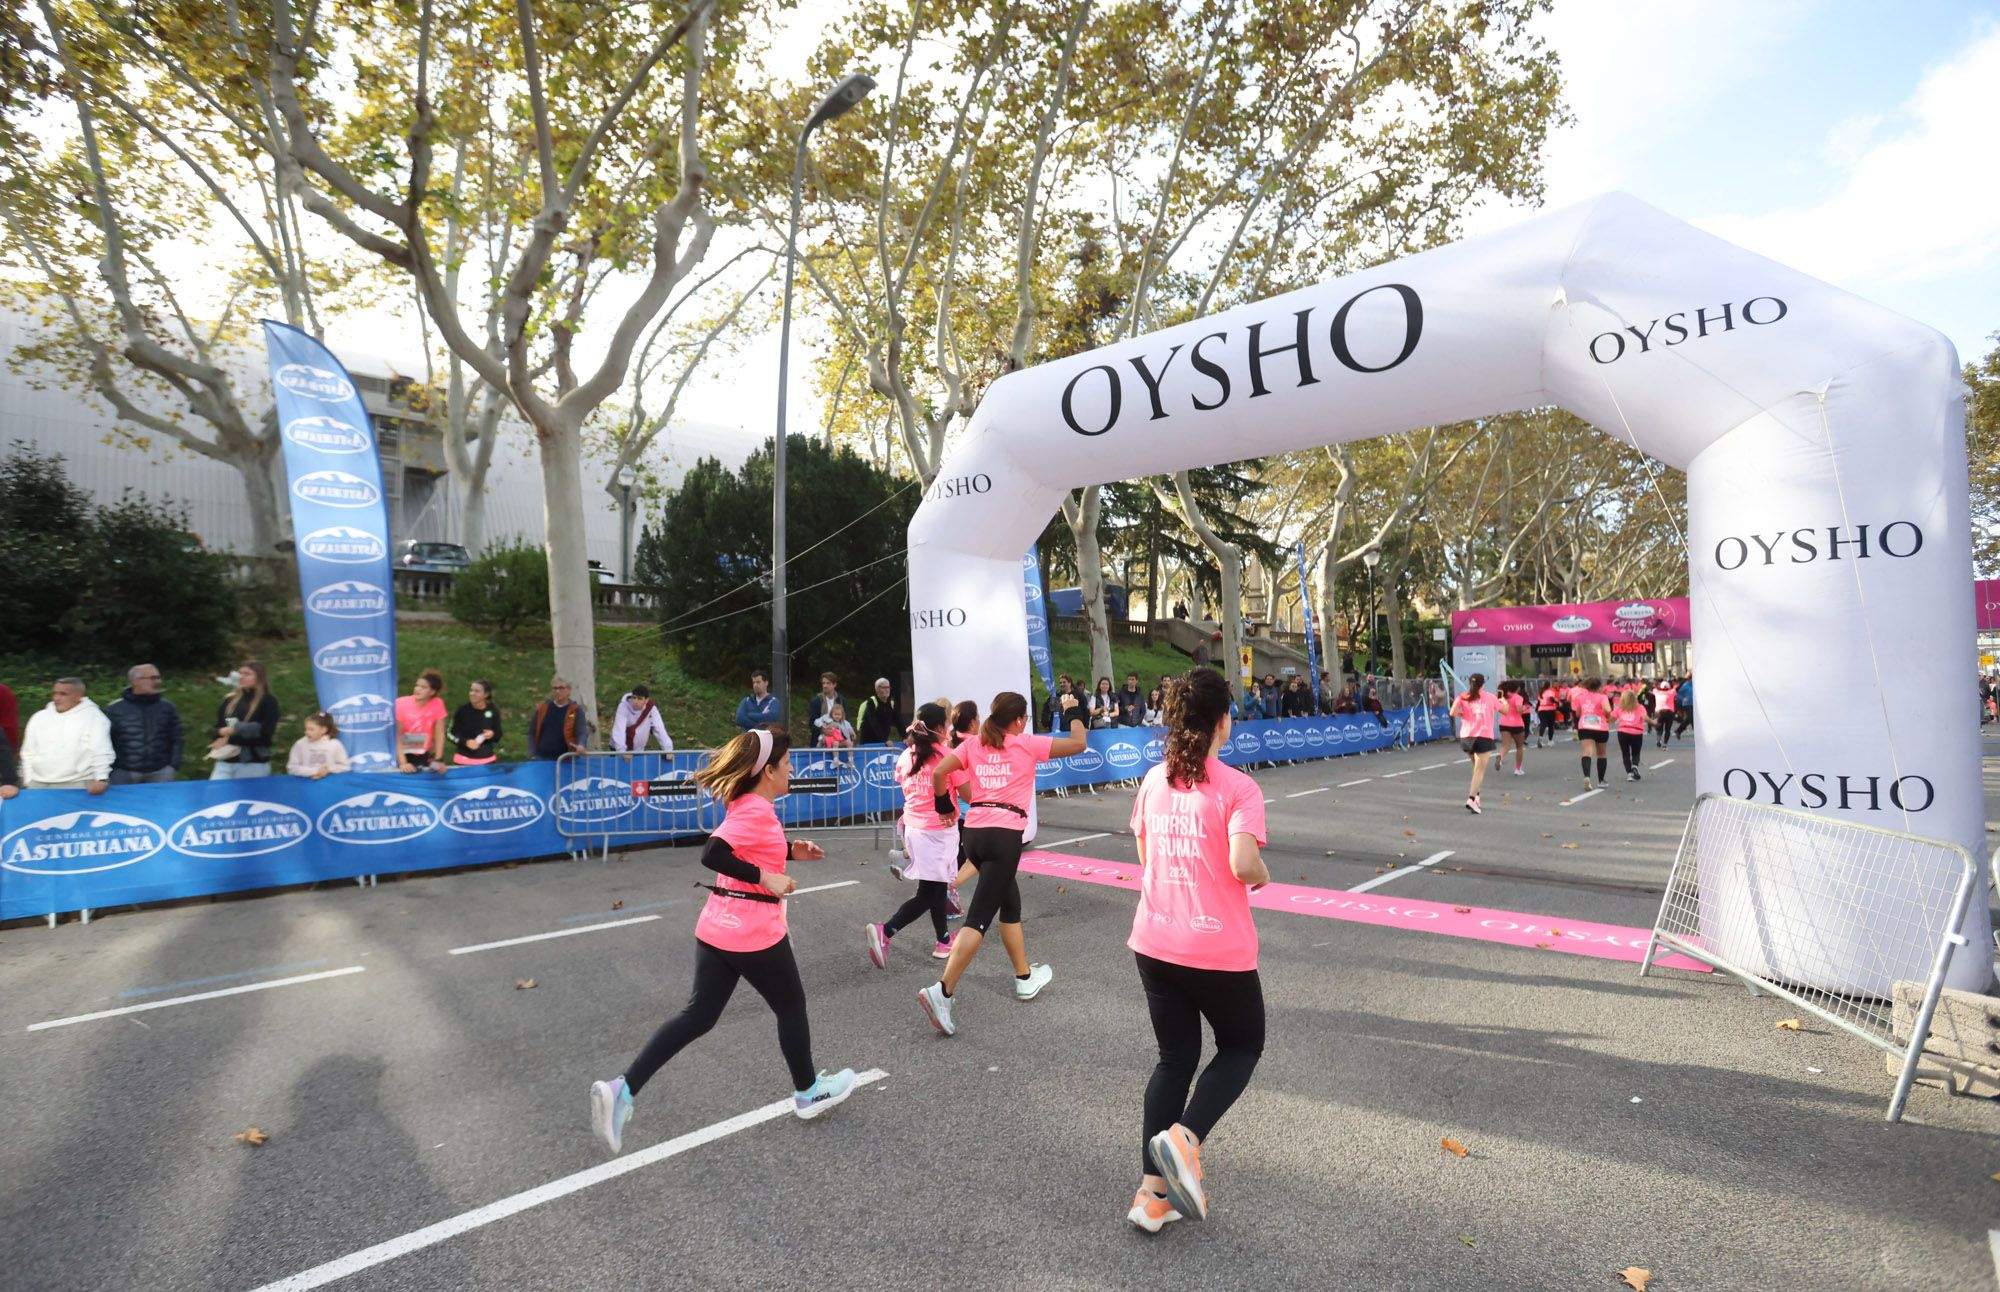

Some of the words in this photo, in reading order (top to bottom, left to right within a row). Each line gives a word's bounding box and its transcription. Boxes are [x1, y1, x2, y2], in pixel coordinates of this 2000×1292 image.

[1589, 296, 1788, 364] OYSHO
[1061, 284, 1423, 436] OYSHO
[1715, 521, 1923, 571] OYSHO
[911, 608, 966, 630] YSHO
[975, 764, 1012, 776] DORSAL
[980, 777, 1008, 789] SUMA
[1723, 768, 1935, 812] OYSHO
[328, 812, 432, 833] ASTURIANA
[449, 804, 538, 824] ASTURIANA
[1151, 813, 1207, 839] DORSAL
[180, 822, 301, 847] ASTURIANA
[1158, 834, 1200, 858] SUMA
[6, 835, 154, 863] ASTURIANA
[1289, 894, 1440, 920] OYSHO
